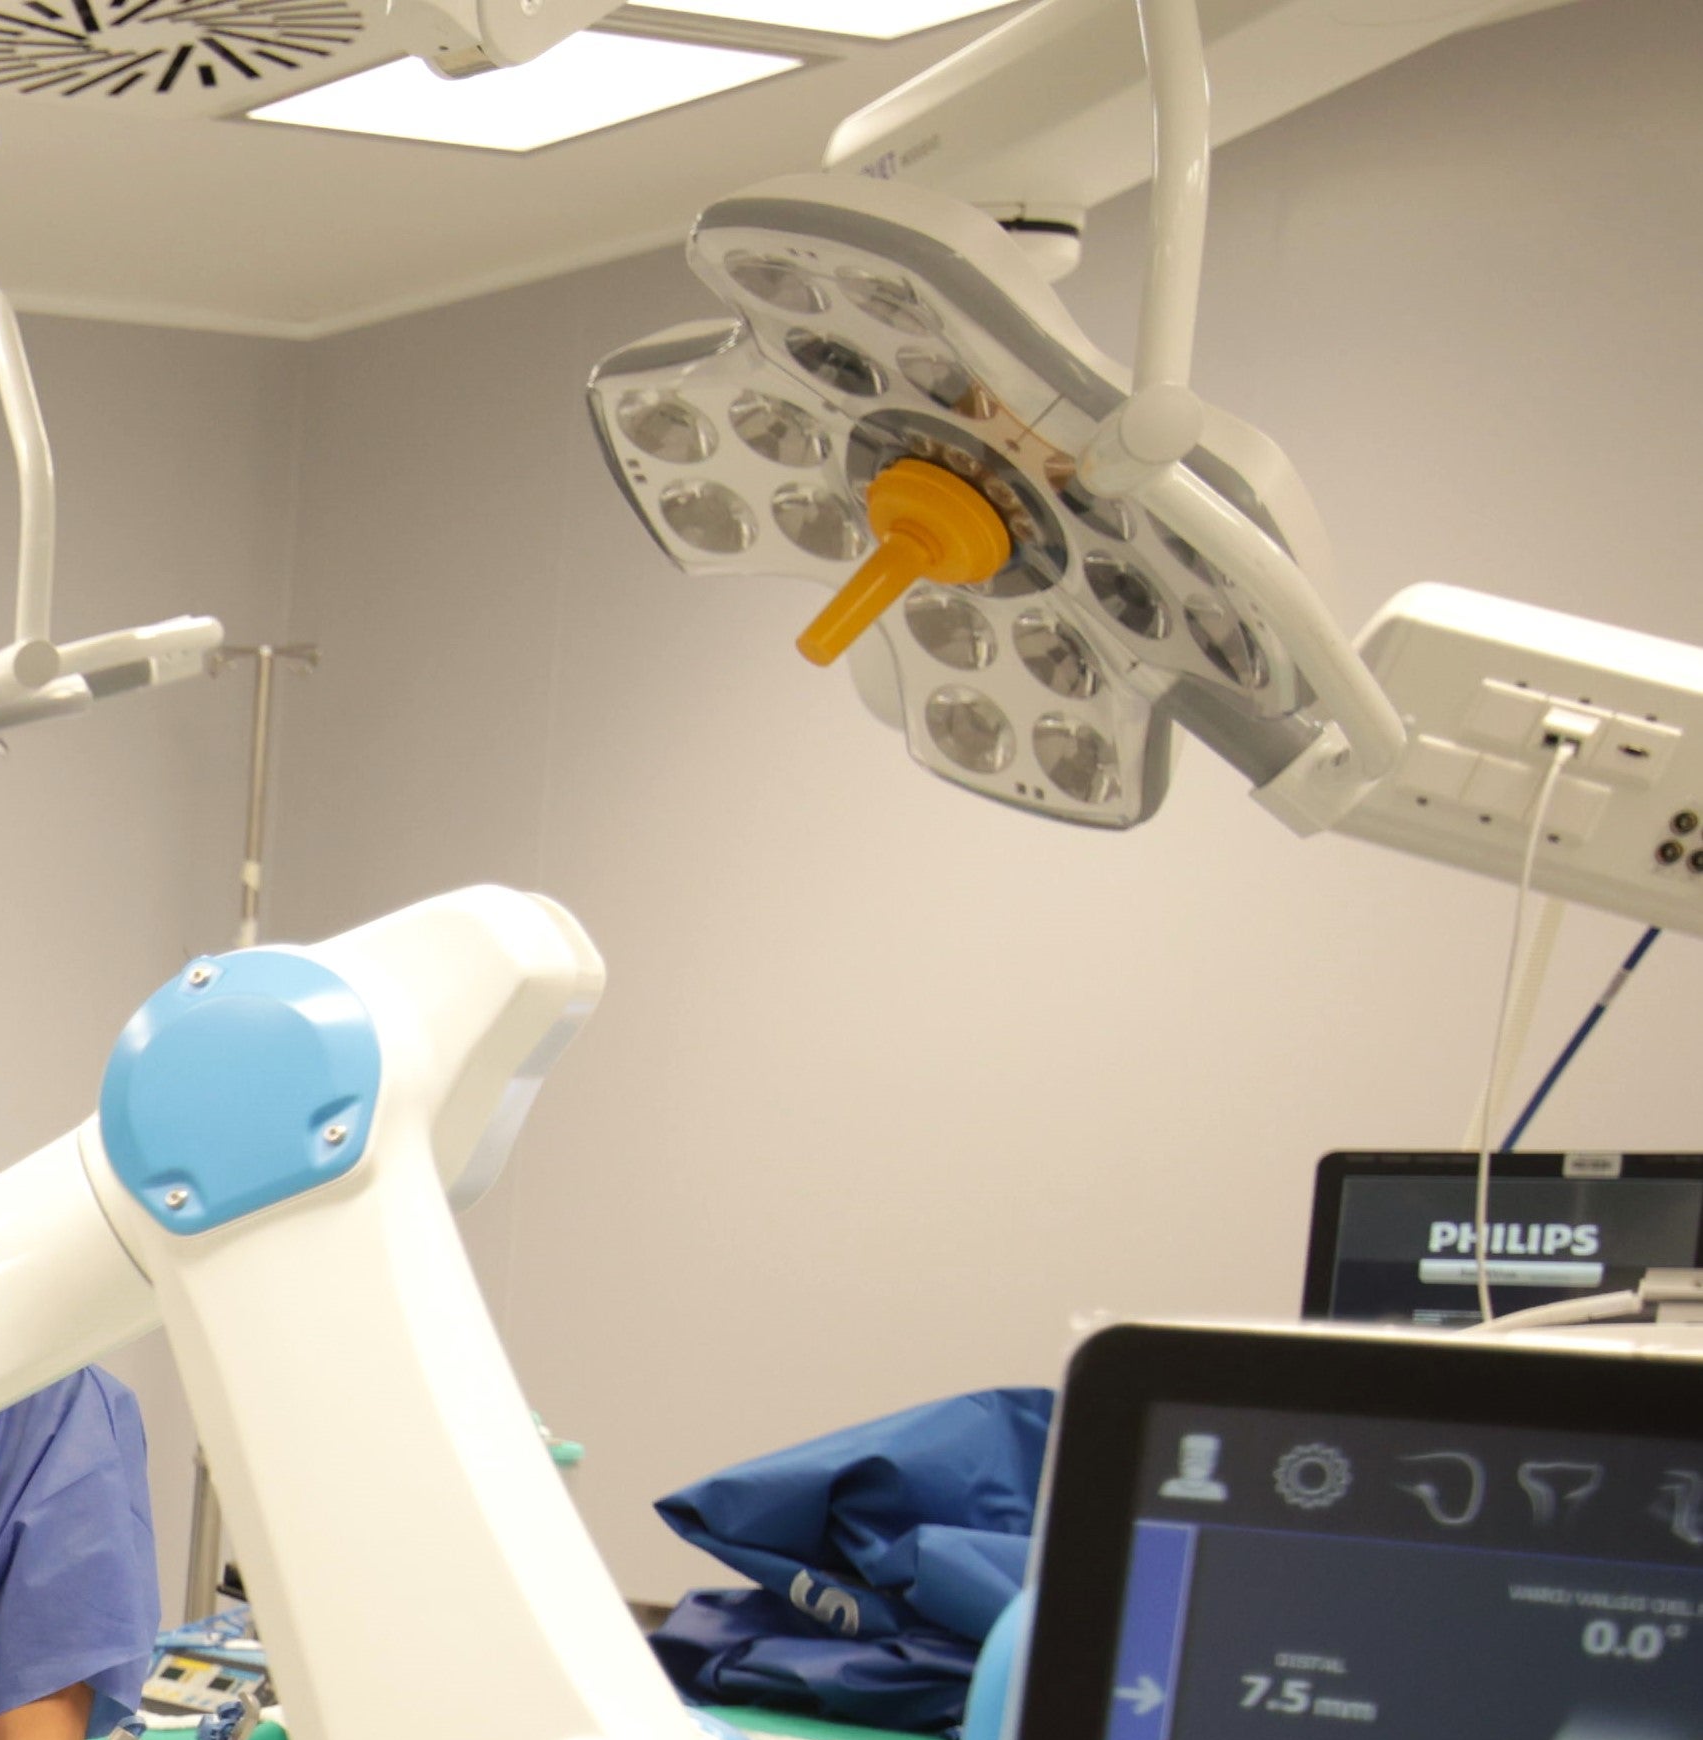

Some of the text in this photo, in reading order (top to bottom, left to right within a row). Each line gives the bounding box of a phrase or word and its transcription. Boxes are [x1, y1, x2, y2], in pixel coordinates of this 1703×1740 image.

[1427, 1221, 1600, 1257] PHILIPS
[1239, 1674, 1377, 1722] 7.5 mm
